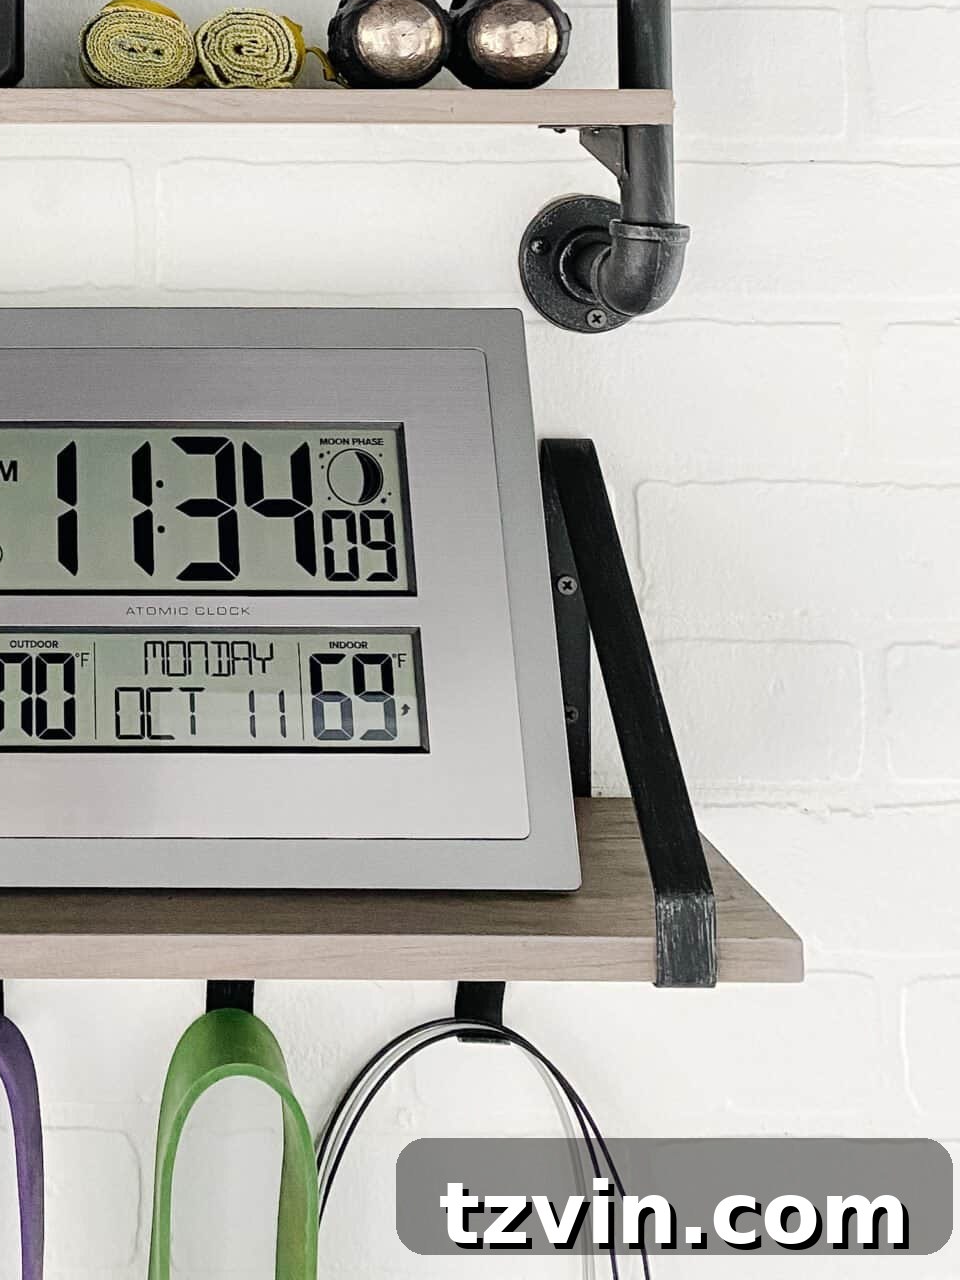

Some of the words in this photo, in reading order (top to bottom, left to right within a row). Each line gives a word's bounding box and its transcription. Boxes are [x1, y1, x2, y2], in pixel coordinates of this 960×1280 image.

[320, 438, 349, 446] MOON
[352, 438, 384, 446] PHASE
[57, 436, 317, 581] 11:34
[322, 510, 398, 581] 09
[126, 606, 189, 616] ATOMIC
[194, 606, 251, 616] CLOCK
[9, 640, 59, 649] OUTDOOR
[144, 641, 274, 677] MONDAY
[329, 641, 368, 649] INDOOR
[115, 687, 205, 740] OCT
[248, 690, 287, 738] 11
[309, 653, 397, 741] 69
